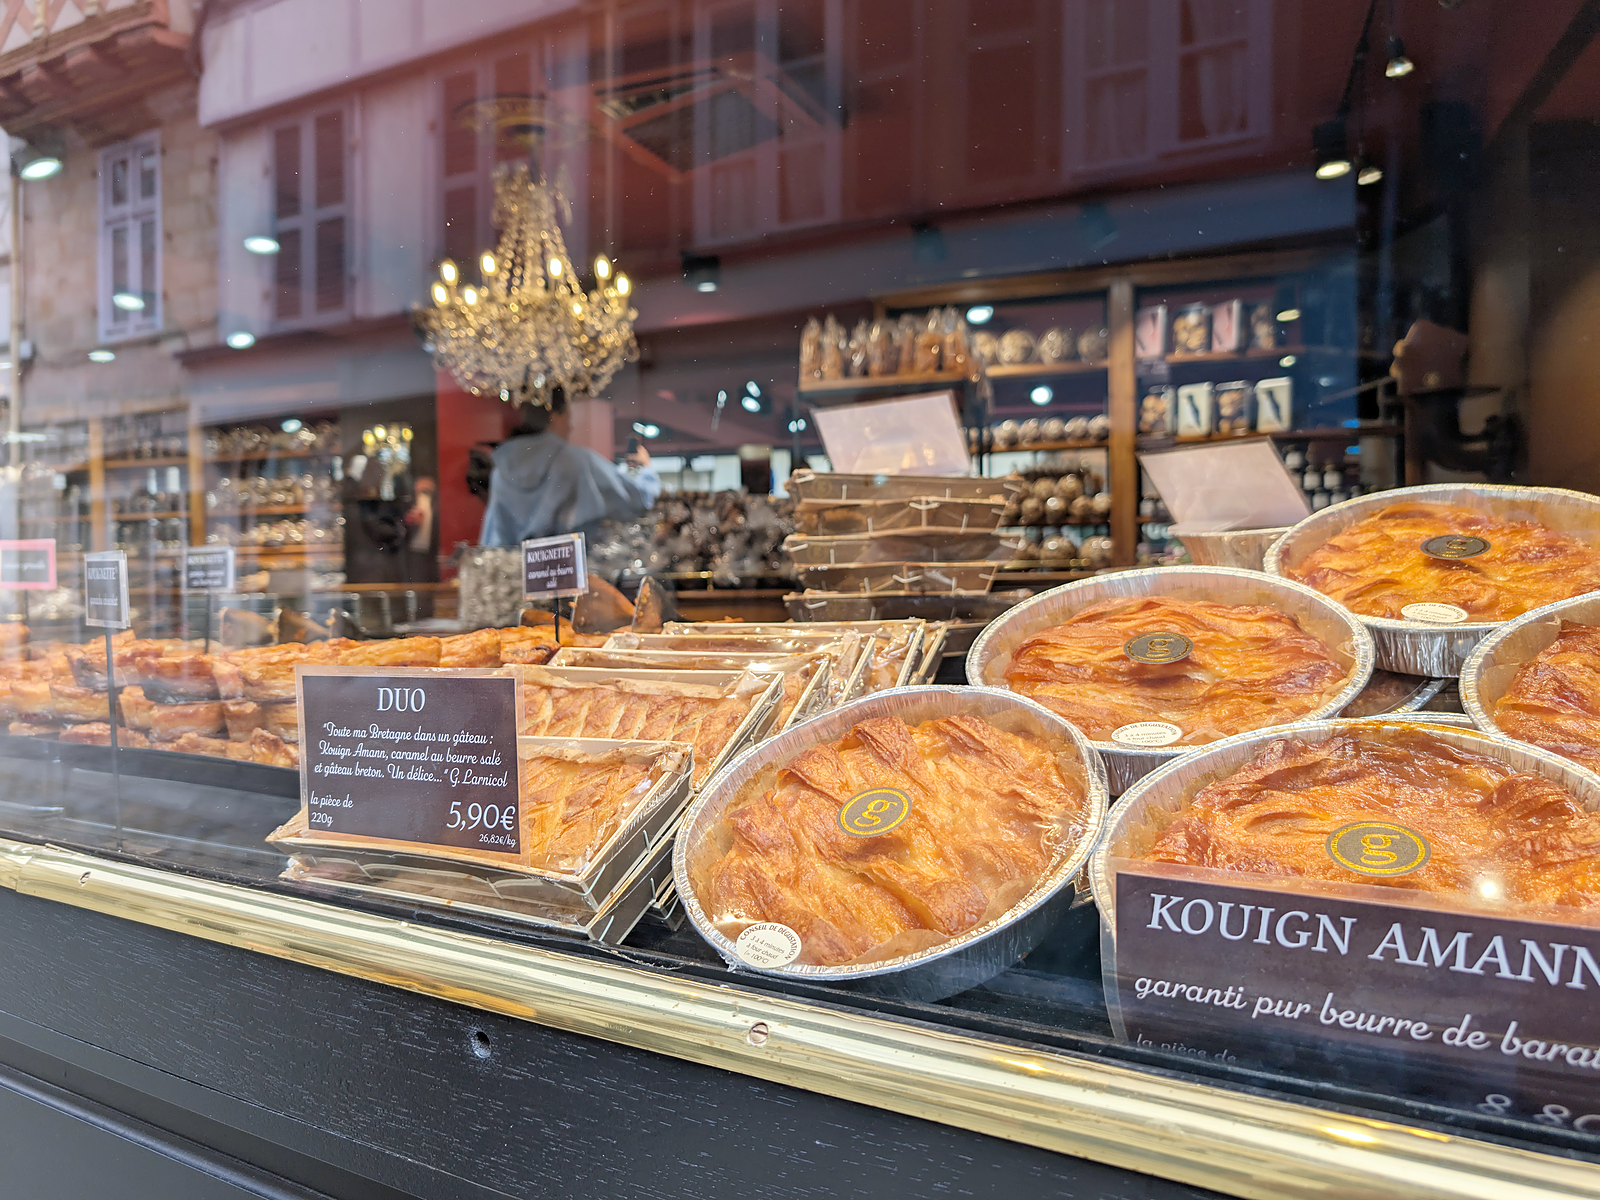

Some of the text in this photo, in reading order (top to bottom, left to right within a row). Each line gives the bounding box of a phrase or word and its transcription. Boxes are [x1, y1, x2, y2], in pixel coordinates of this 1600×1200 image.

[1145, 638, 1175, 658] g
[377, 687, 427, 713] DUO
[352, 728, 368, 739] ma
[369, 723, 412, 744] Bretagne
[413, 726, 436, 742] dans
[438, 732, 452, 742] un
[452, 730, 488, 746] gâteau
[318, 740, 502, 766] Kouign Amann, caramel au beurre salé
[314, 762, 324, 773] et
[324, 762, 354, 778] gâteau
[354, 761, 385, 778] breton.
[387, 763, 405, 780] Un
[310, 790, 354, 808] la pièce de
[310, 812, 334, 828] 220g
[446, 800, 517, 832] 5,90€
[853, 798, 898, 827] g
[478, 833, 518, 848] 26,82€/kg
[1360, 833, 1400, 866] g
[740, 924, 768, 941] CONSEIL
[768, 924, 778, 932] DE
[1146, 893, 1358, 956] KOUIGN
[1134, 977, 1248, 1010] garanti
[1251, 996, 1312, 1020] pur
[1319, 992, 1434, 1041] beurre
[1441, 1013, 1492, 1051] de
